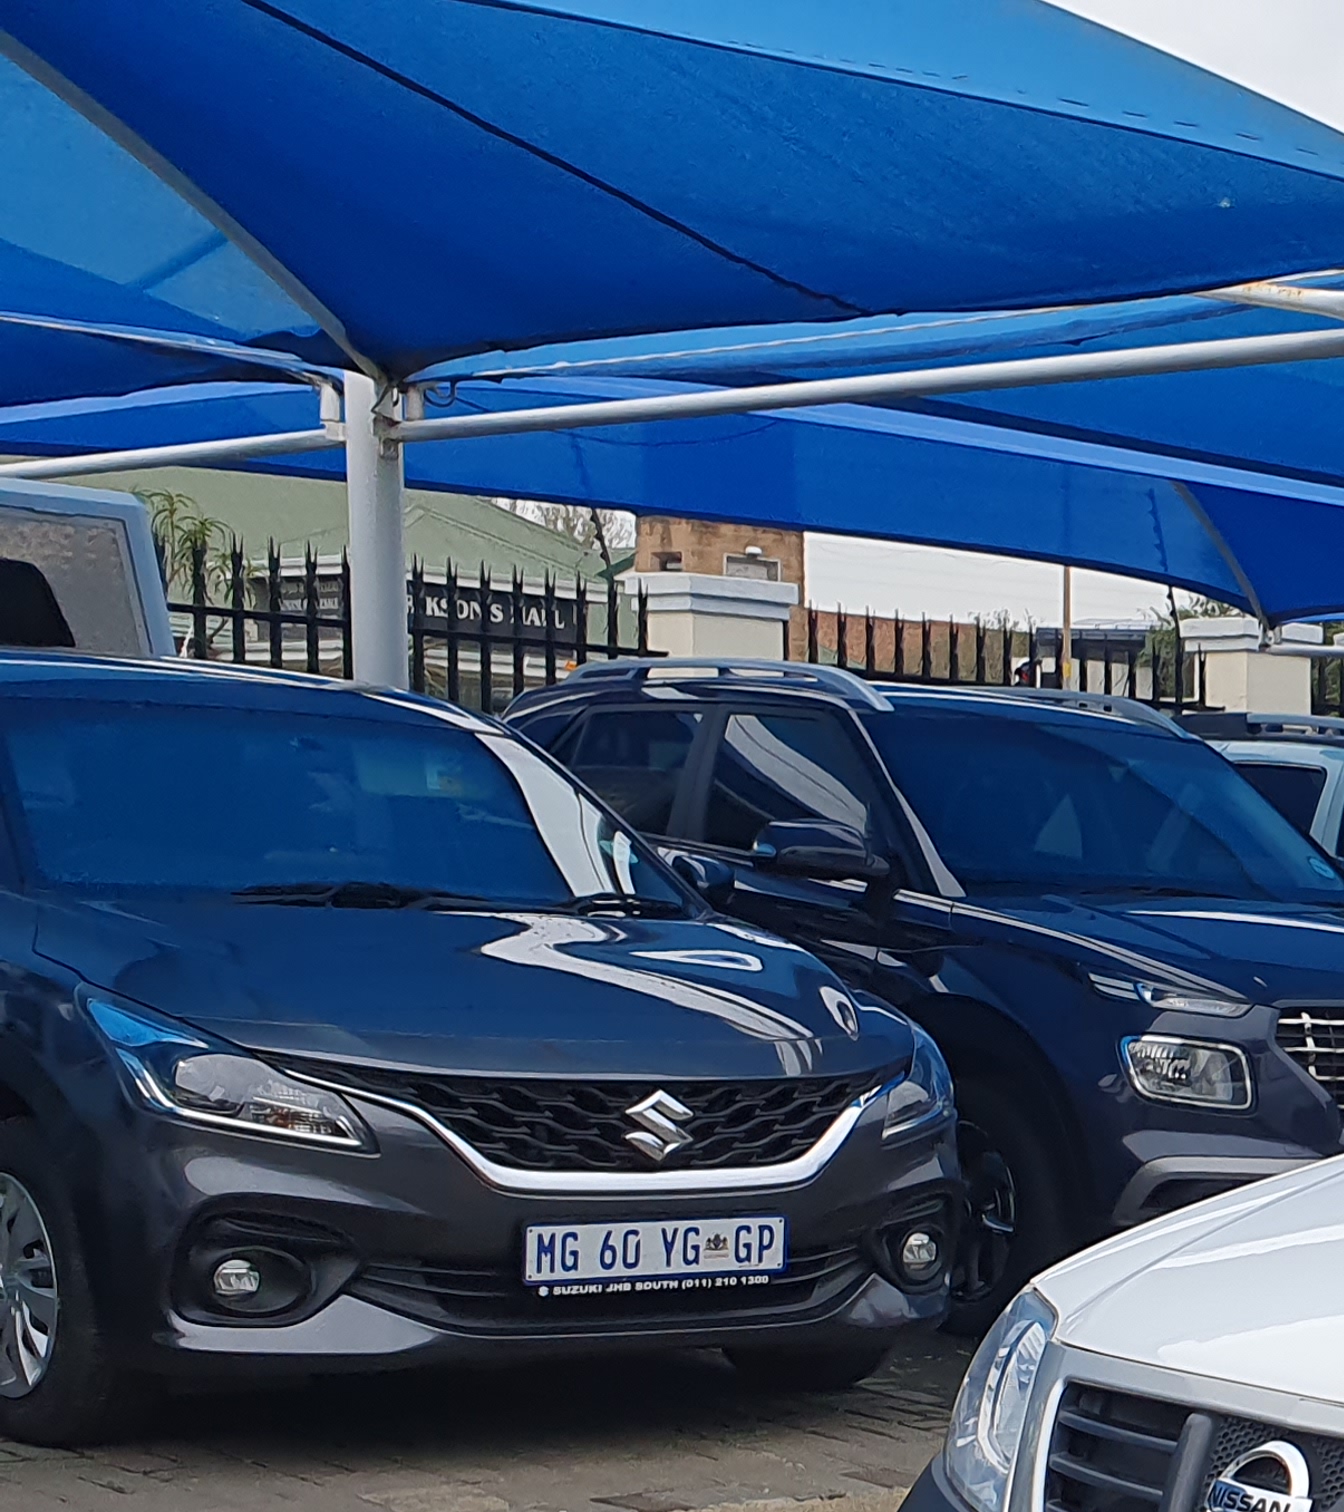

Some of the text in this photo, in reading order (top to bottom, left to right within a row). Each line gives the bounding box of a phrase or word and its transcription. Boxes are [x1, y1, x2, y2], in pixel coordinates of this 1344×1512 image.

[536, 1224, 775, 1275] MG 60 YG GP
[552, 1283, 602, 1296] SUZUKI
[605, 1282, 632, 1293] JHB
[635, 1280, 679, 1292] SOUTH
[682, 1278, 712, 1290] (011)
[715, 1276, 737, 1287] 210
